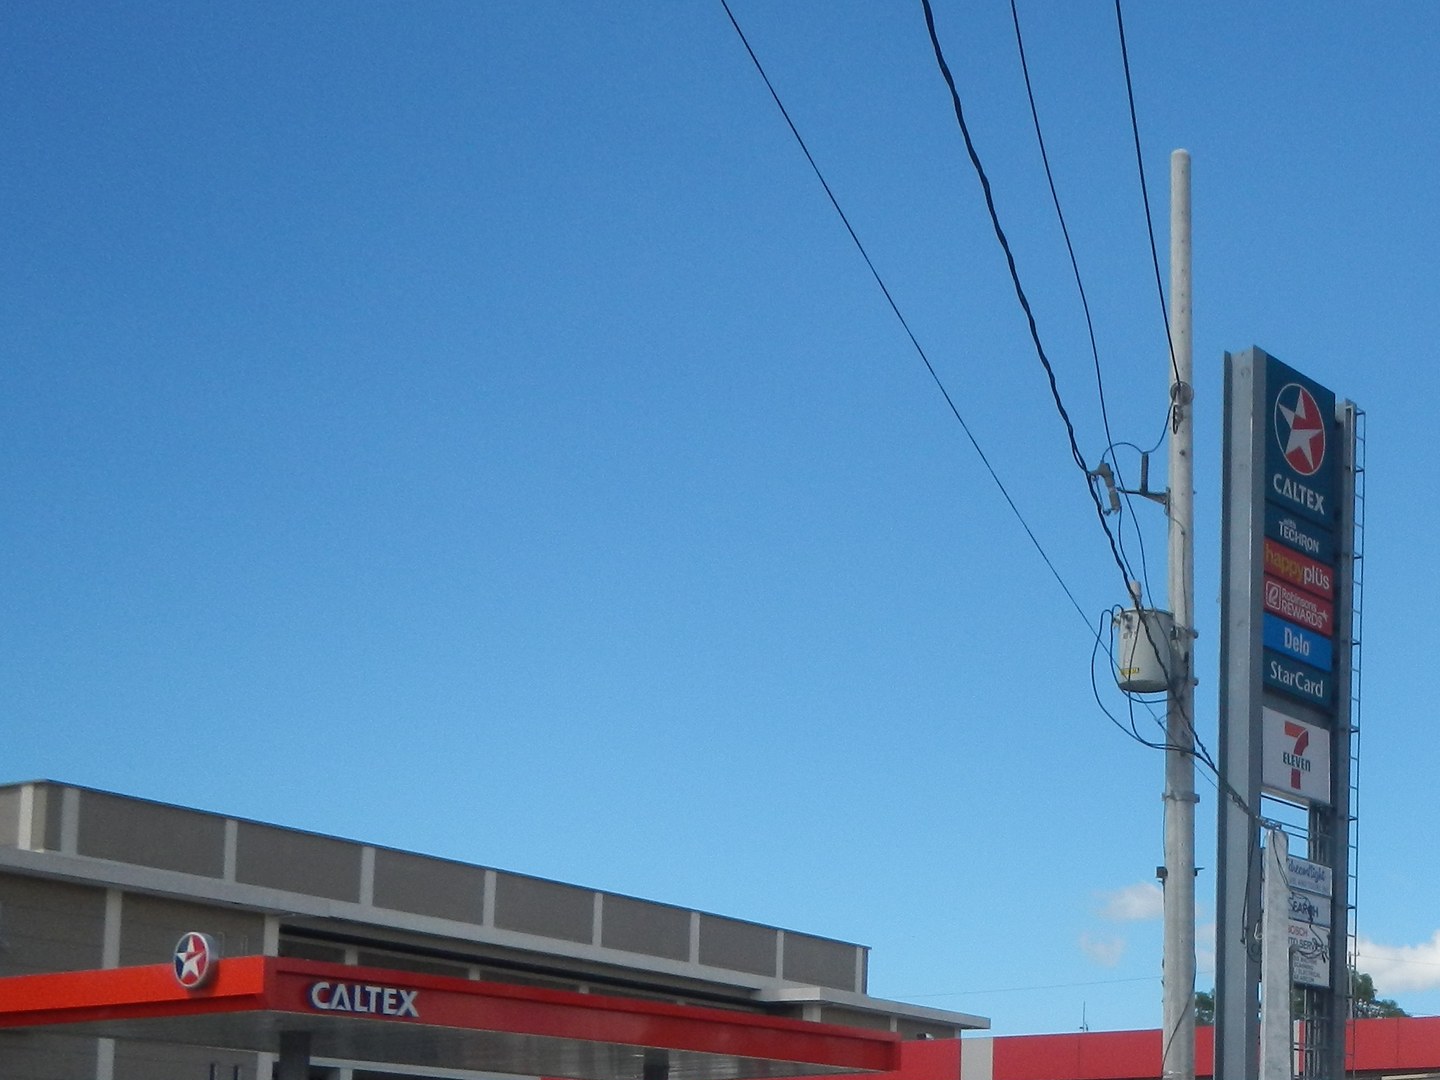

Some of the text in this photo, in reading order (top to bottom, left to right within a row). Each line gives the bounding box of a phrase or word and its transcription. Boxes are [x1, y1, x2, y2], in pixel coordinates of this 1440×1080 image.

[1273, 473, 1325, 516] CALTEX
[1279, 520, 1319, 553] TECHRON
[1280, 599, 1323, 629] REWARDS
[1281, 587, 1318, 613] Robinsons
[1284, 626, 1310, 657] Delo
[1270, 660, 1323, 697] StarCard
[1284, 720, 1309, 790] 7
[311, 981, 419, 1017] CALTEX
